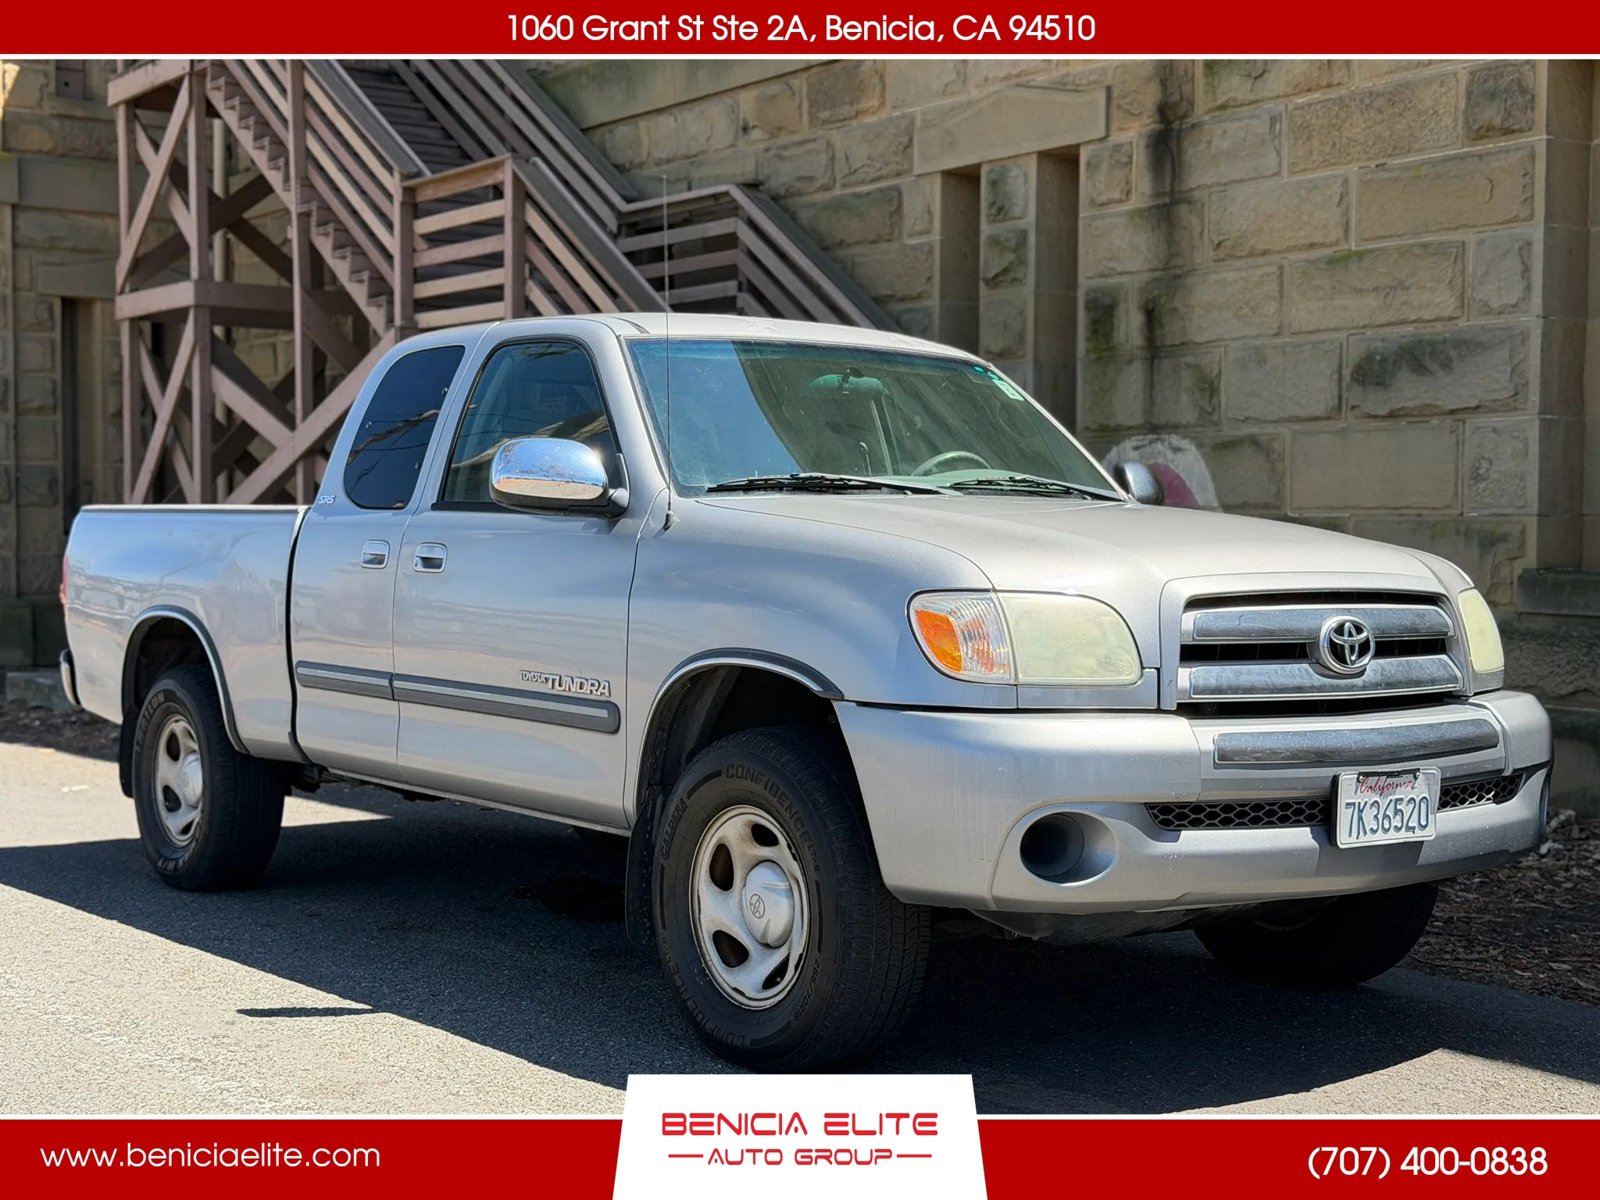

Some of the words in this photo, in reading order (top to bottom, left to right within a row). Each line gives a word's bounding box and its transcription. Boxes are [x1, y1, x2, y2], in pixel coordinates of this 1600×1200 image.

[543, 673, 611, 698] TUNDRA
[1360, 776, 1415, 796] California
[1344, 795, 1430, 839] 7K36520
